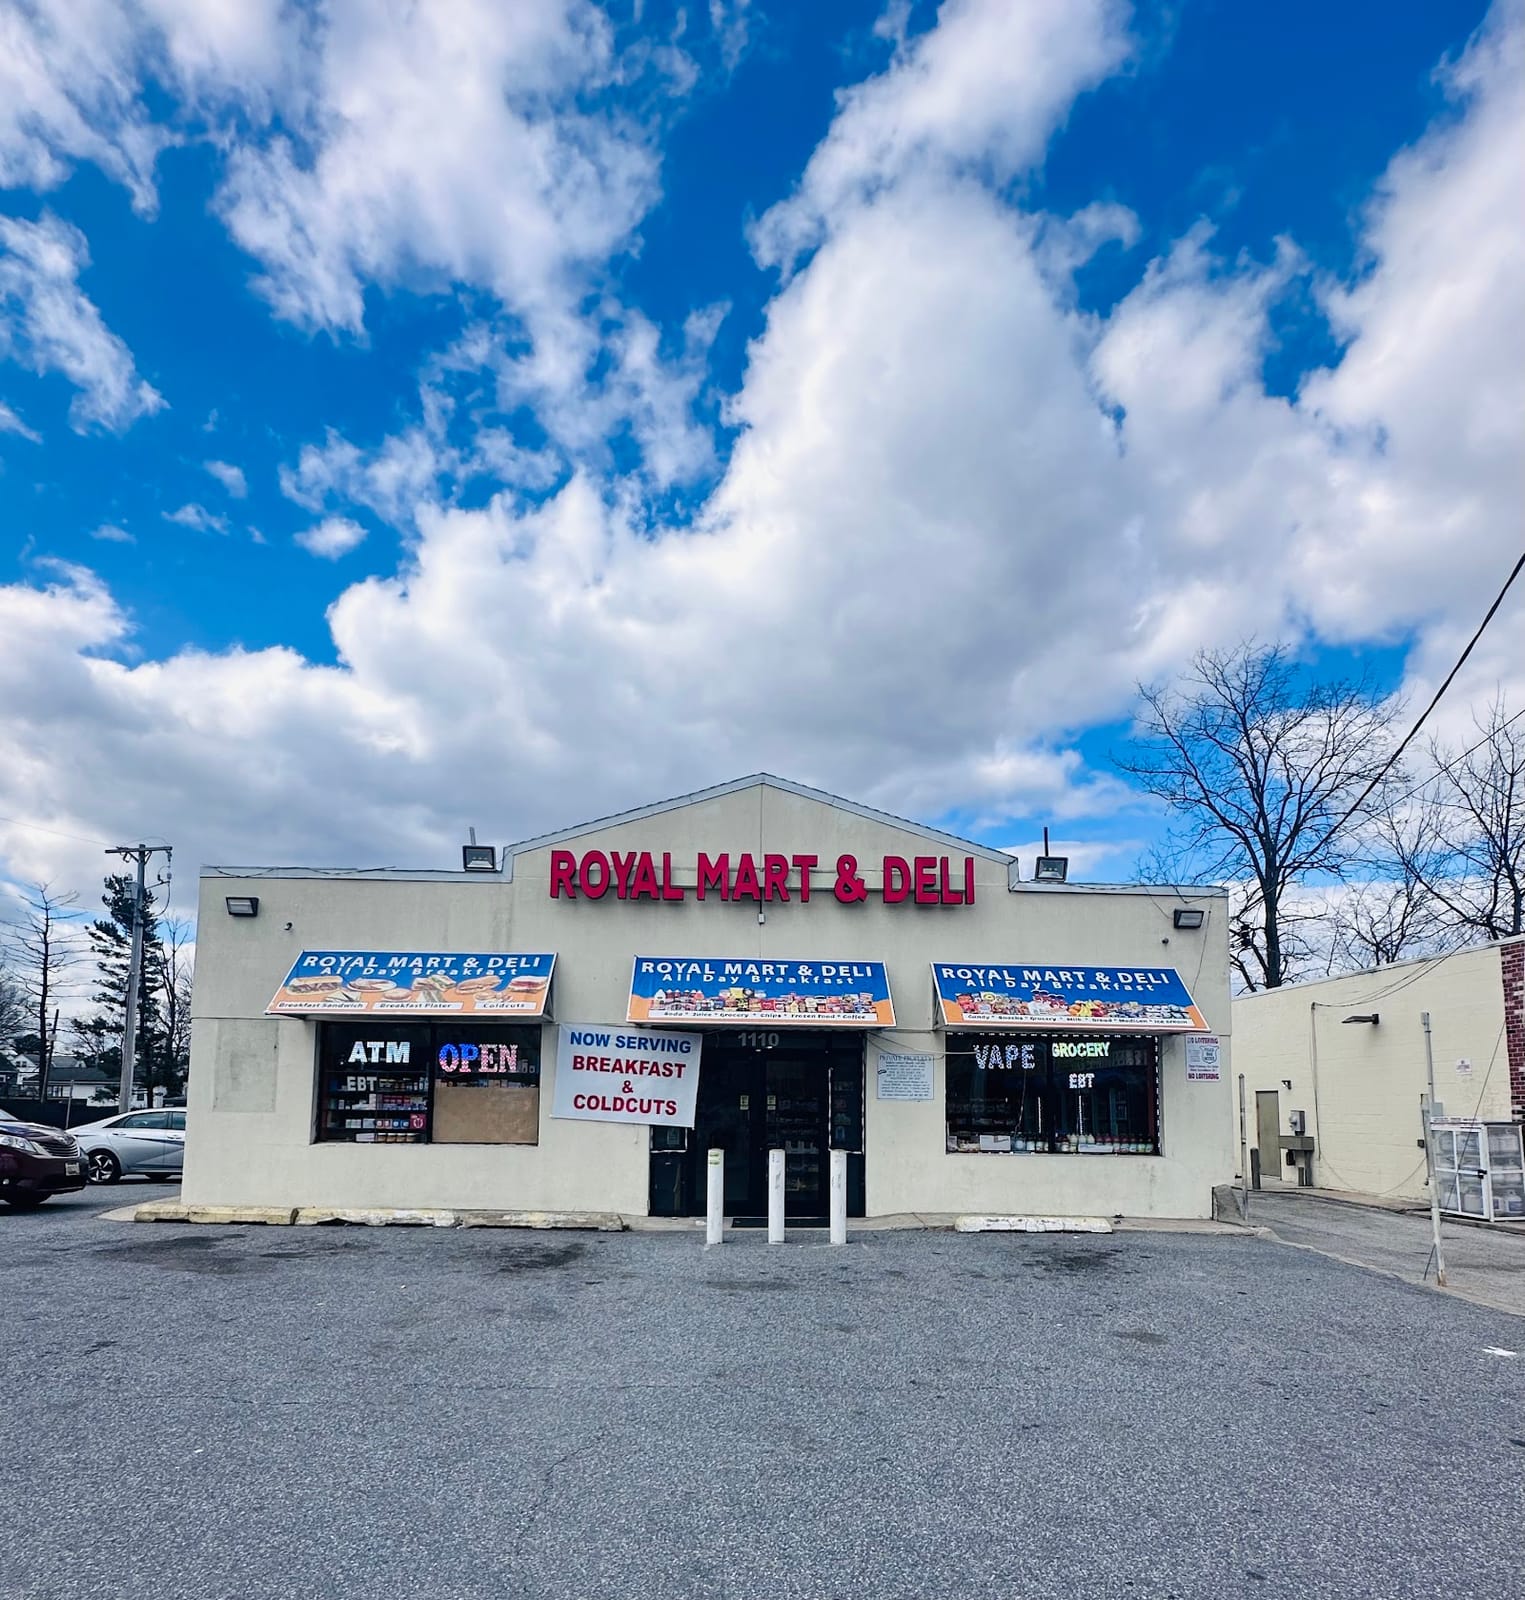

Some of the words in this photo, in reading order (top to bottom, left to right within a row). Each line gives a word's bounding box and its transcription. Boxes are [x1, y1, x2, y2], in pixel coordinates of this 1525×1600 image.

[550, 850, 684, 902] ROYAL
[697, 852, 818, 903] MART
[834, 854, 869, 904] &
[883, 855, 976, 905] DELI
[303, 956, 379, 968] ROYAL
[388, 957, 458, 968] MART
[463, 957, 480, 968] &
[488, 957, 541, 968] DELI
[641, 962, 715, 975] ROYAL
[724, 964, 789, 976] MART
[797, 964, 814, 976] &
[822, 965, 873, 977] DELI
[320, 967, 351, 976] All
[364, 968, 401, 977] Day
[412, 967, 518, 976] Breakfast
[662, 974, 691, 982] All
[703, 974, 739, 984] Day
[751, 975, 856, 985] Breakfast
[942, 968, 1016, 981] ROYAL
[1023, 970, 1086, 982] MART
[1095, 972, 1111, 983] &
[1118, 973, 1169, 984] DELI
[966, 979, 994, 987] All
[1006, 980, 1042, 990] Day
[1052, 982, 1156, 992] Breakfast
[570, 1032, 610, 1047] NOW
[615, 1035, 691, 1053] SERVING
[738, 1032, 779, 1047] 1110
[348, 1041, 410, 1063] ATM
[438, 1043, 518, 1073] OPEN
[973, 1044, 1035, 1069] VAPE
[1052, 1042, 1110, 1058] GROCERY
[573, 1056, 686, 1078] BREAKFAST
[346, 1076, 377, 1092] EBT
[622, 1080, 634, 1093] &
[1068, 1073, 1095, 1089] EBT
[573, 1094, 677, 1116] COLDCUTS
